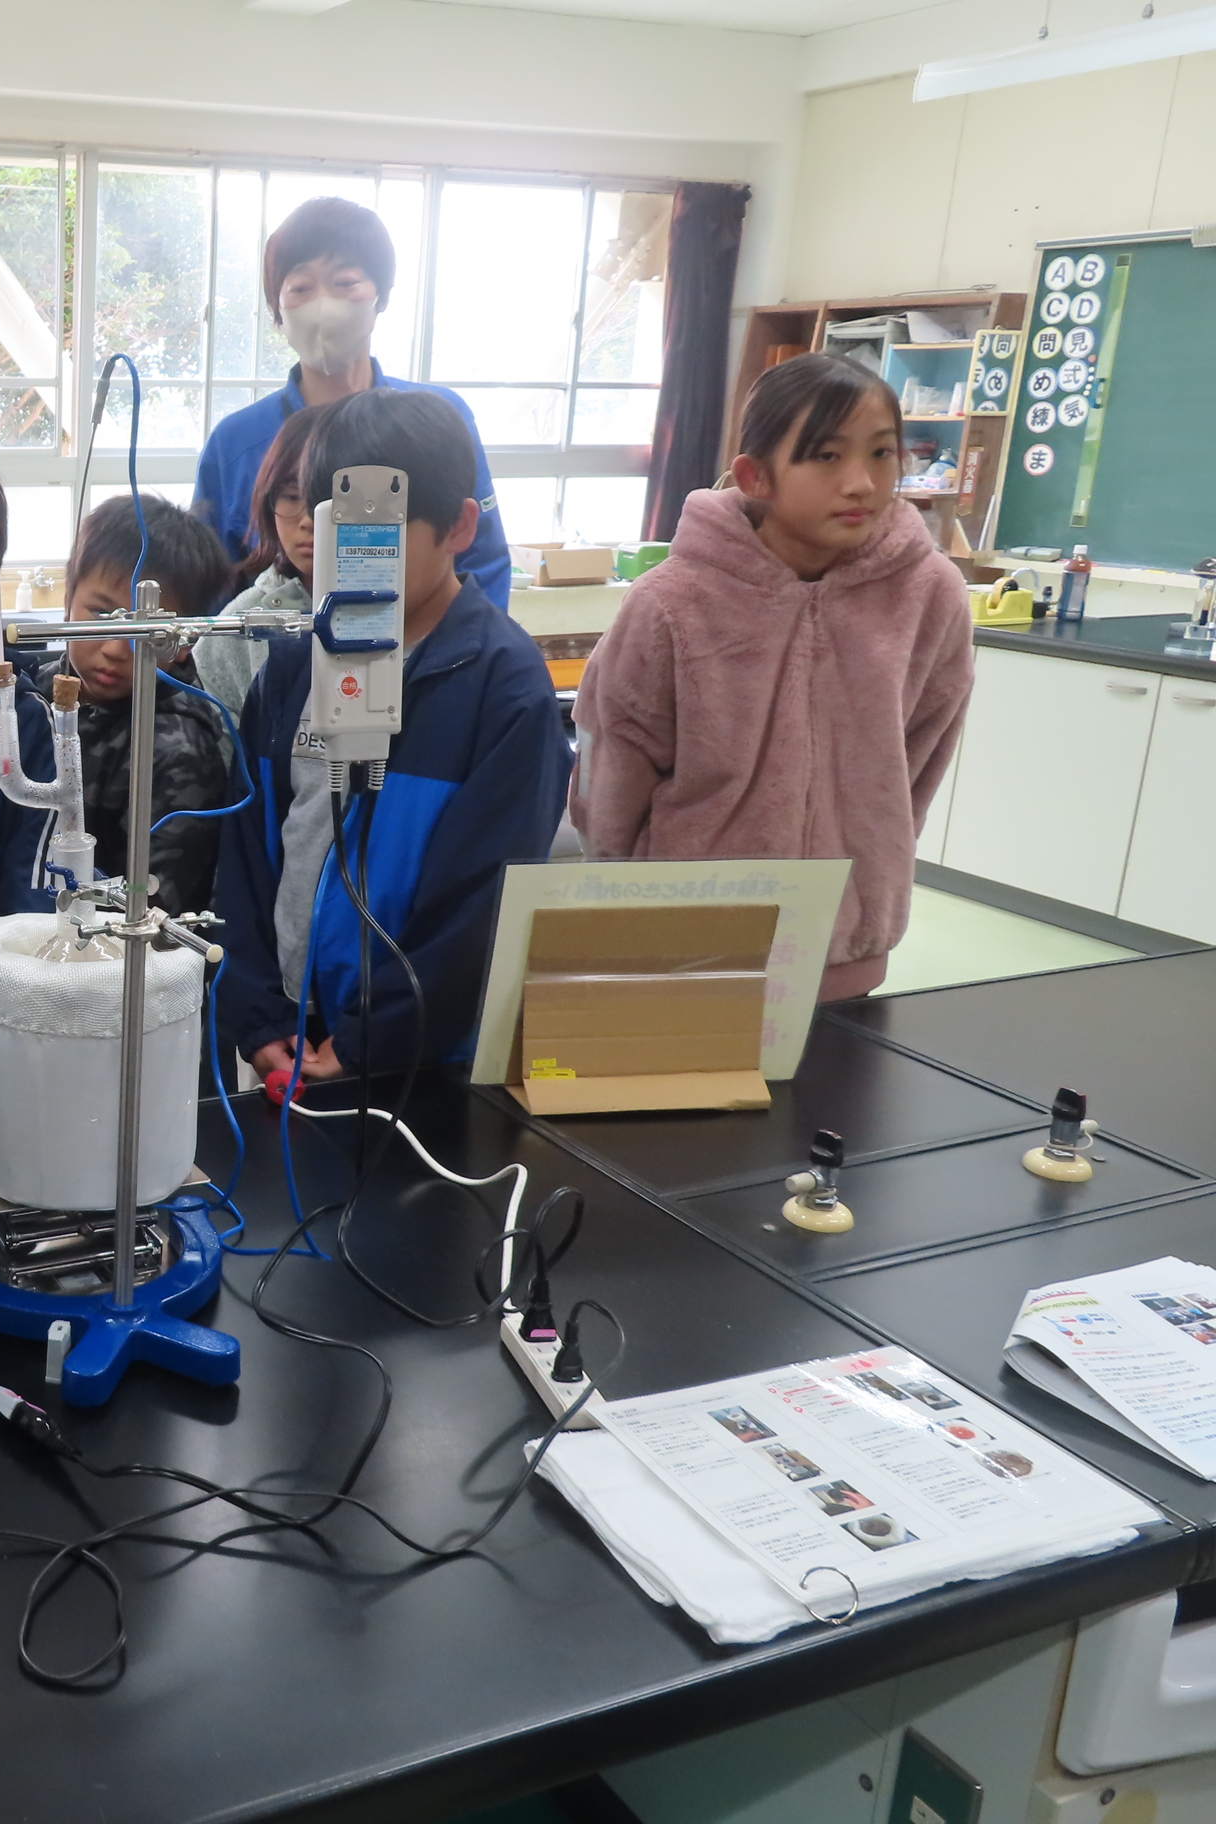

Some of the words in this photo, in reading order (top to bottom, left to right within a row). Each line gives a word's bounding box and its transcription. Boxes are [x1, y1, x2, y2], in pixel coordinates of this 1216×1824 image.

[1051, 262, 1067, 283] A
[1080, 260, 1099, 282] B
[1046, 297, 1063, 318] C
[1077, 298, 1094, 319] D
[1038, 333, 1057, 354] 問
[1069, 332, 1088, 354] 見
[1033, 374, 1052, 392] め
[1063, 364, 1082, 385] 式
[1031, 406, 1051, 427] 練
[1063, 400, 1084, 422] 気
[1029, 450, 1048, 470] ま
